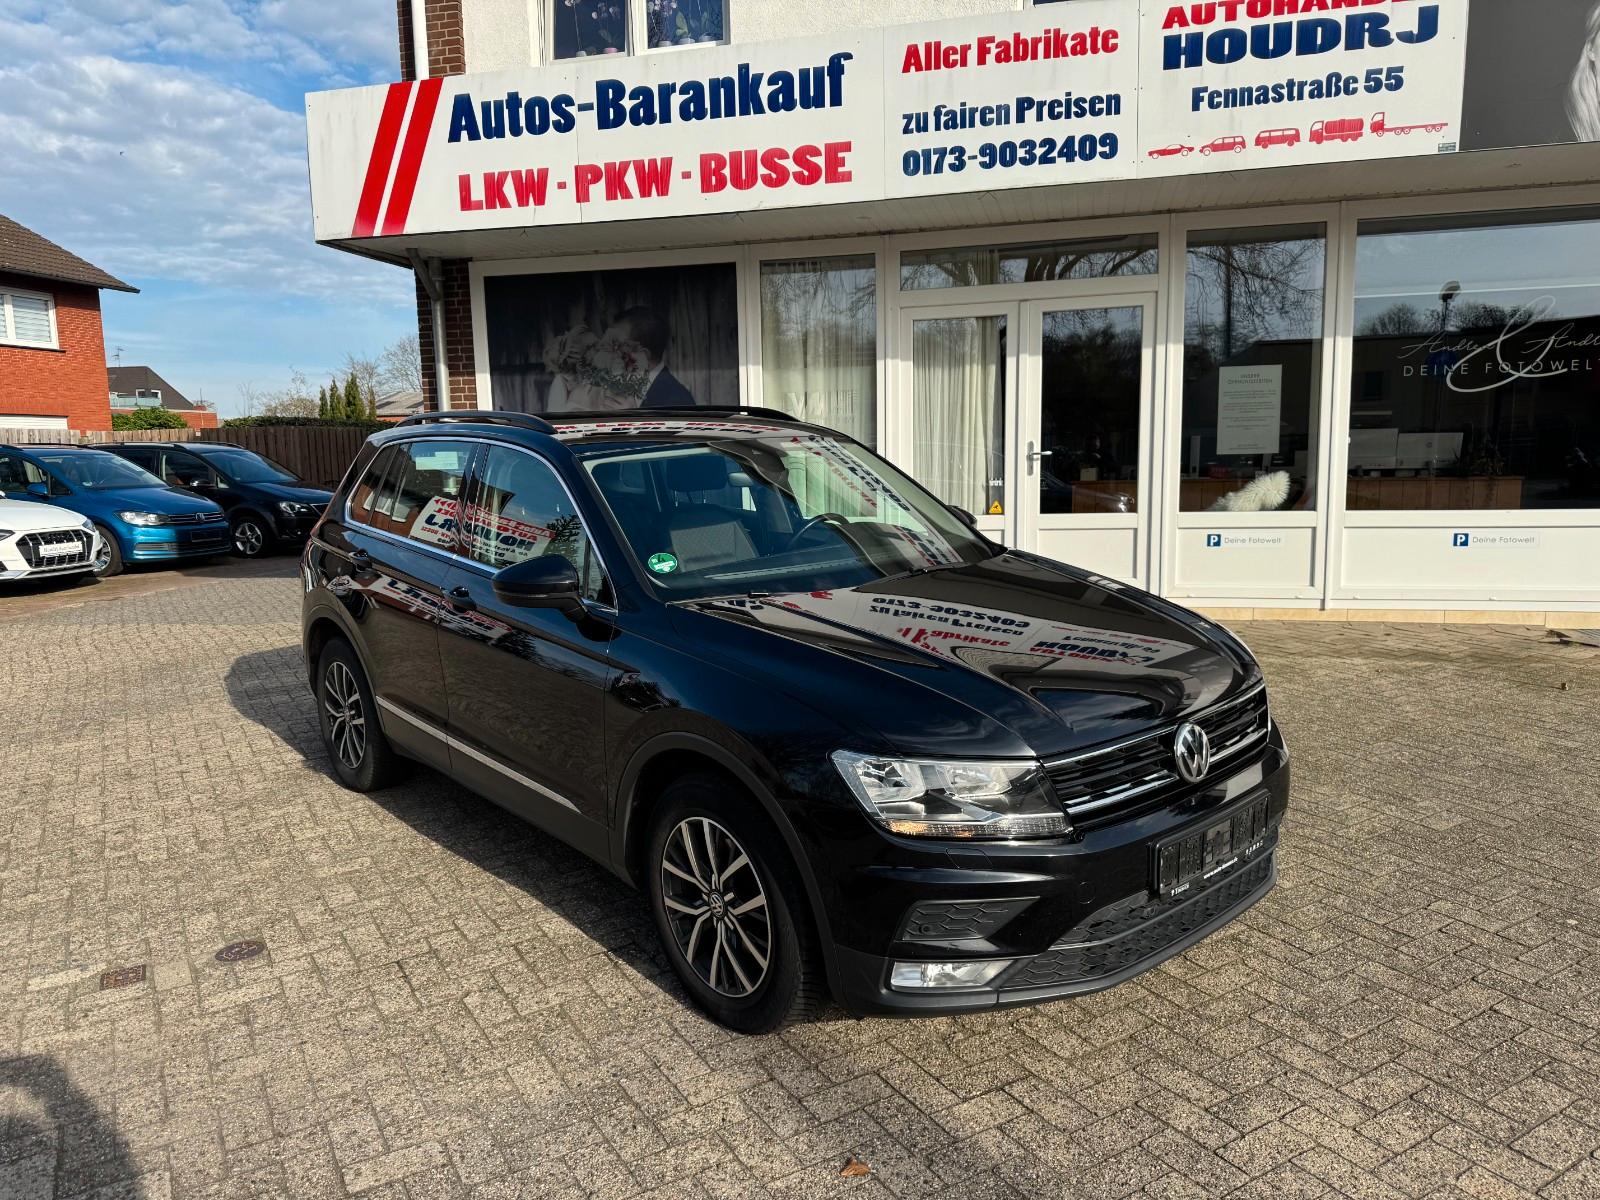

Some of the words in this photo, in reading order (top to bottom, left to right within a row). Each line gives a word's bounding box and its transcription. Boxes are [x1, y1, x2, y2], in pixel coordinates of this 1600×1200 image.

[1161, 0, 1408, 29] AUTOHA
[1164, 5, 1439, 69] HOUDRJ
[901, 40, 971, 74] Aller
[976, 27, 1120, 66] Fabrikate
[448, 52, 853, 143] Autos-Barankauf
[1191, 72, 1358, 112] Fennastraße
[1366, 67, 1404, 94] 55
[902, 112, 928, 134] zu
[934, 104, 1010, 131] fairen
[1016, 95, 1121, 124] Preisen
[458, 168, 550, 212] LKW
[573, 157, 673, 204] PKW
[699, 141, 853, 194] BUSSE
[902, 132, 1119, 177] 0173-9032409
[1403, 362, 1469, 377] DEINE
[1485, 358, 1600, 374] FOTOWEL
[1472, 536, 1496, 544] Deine
